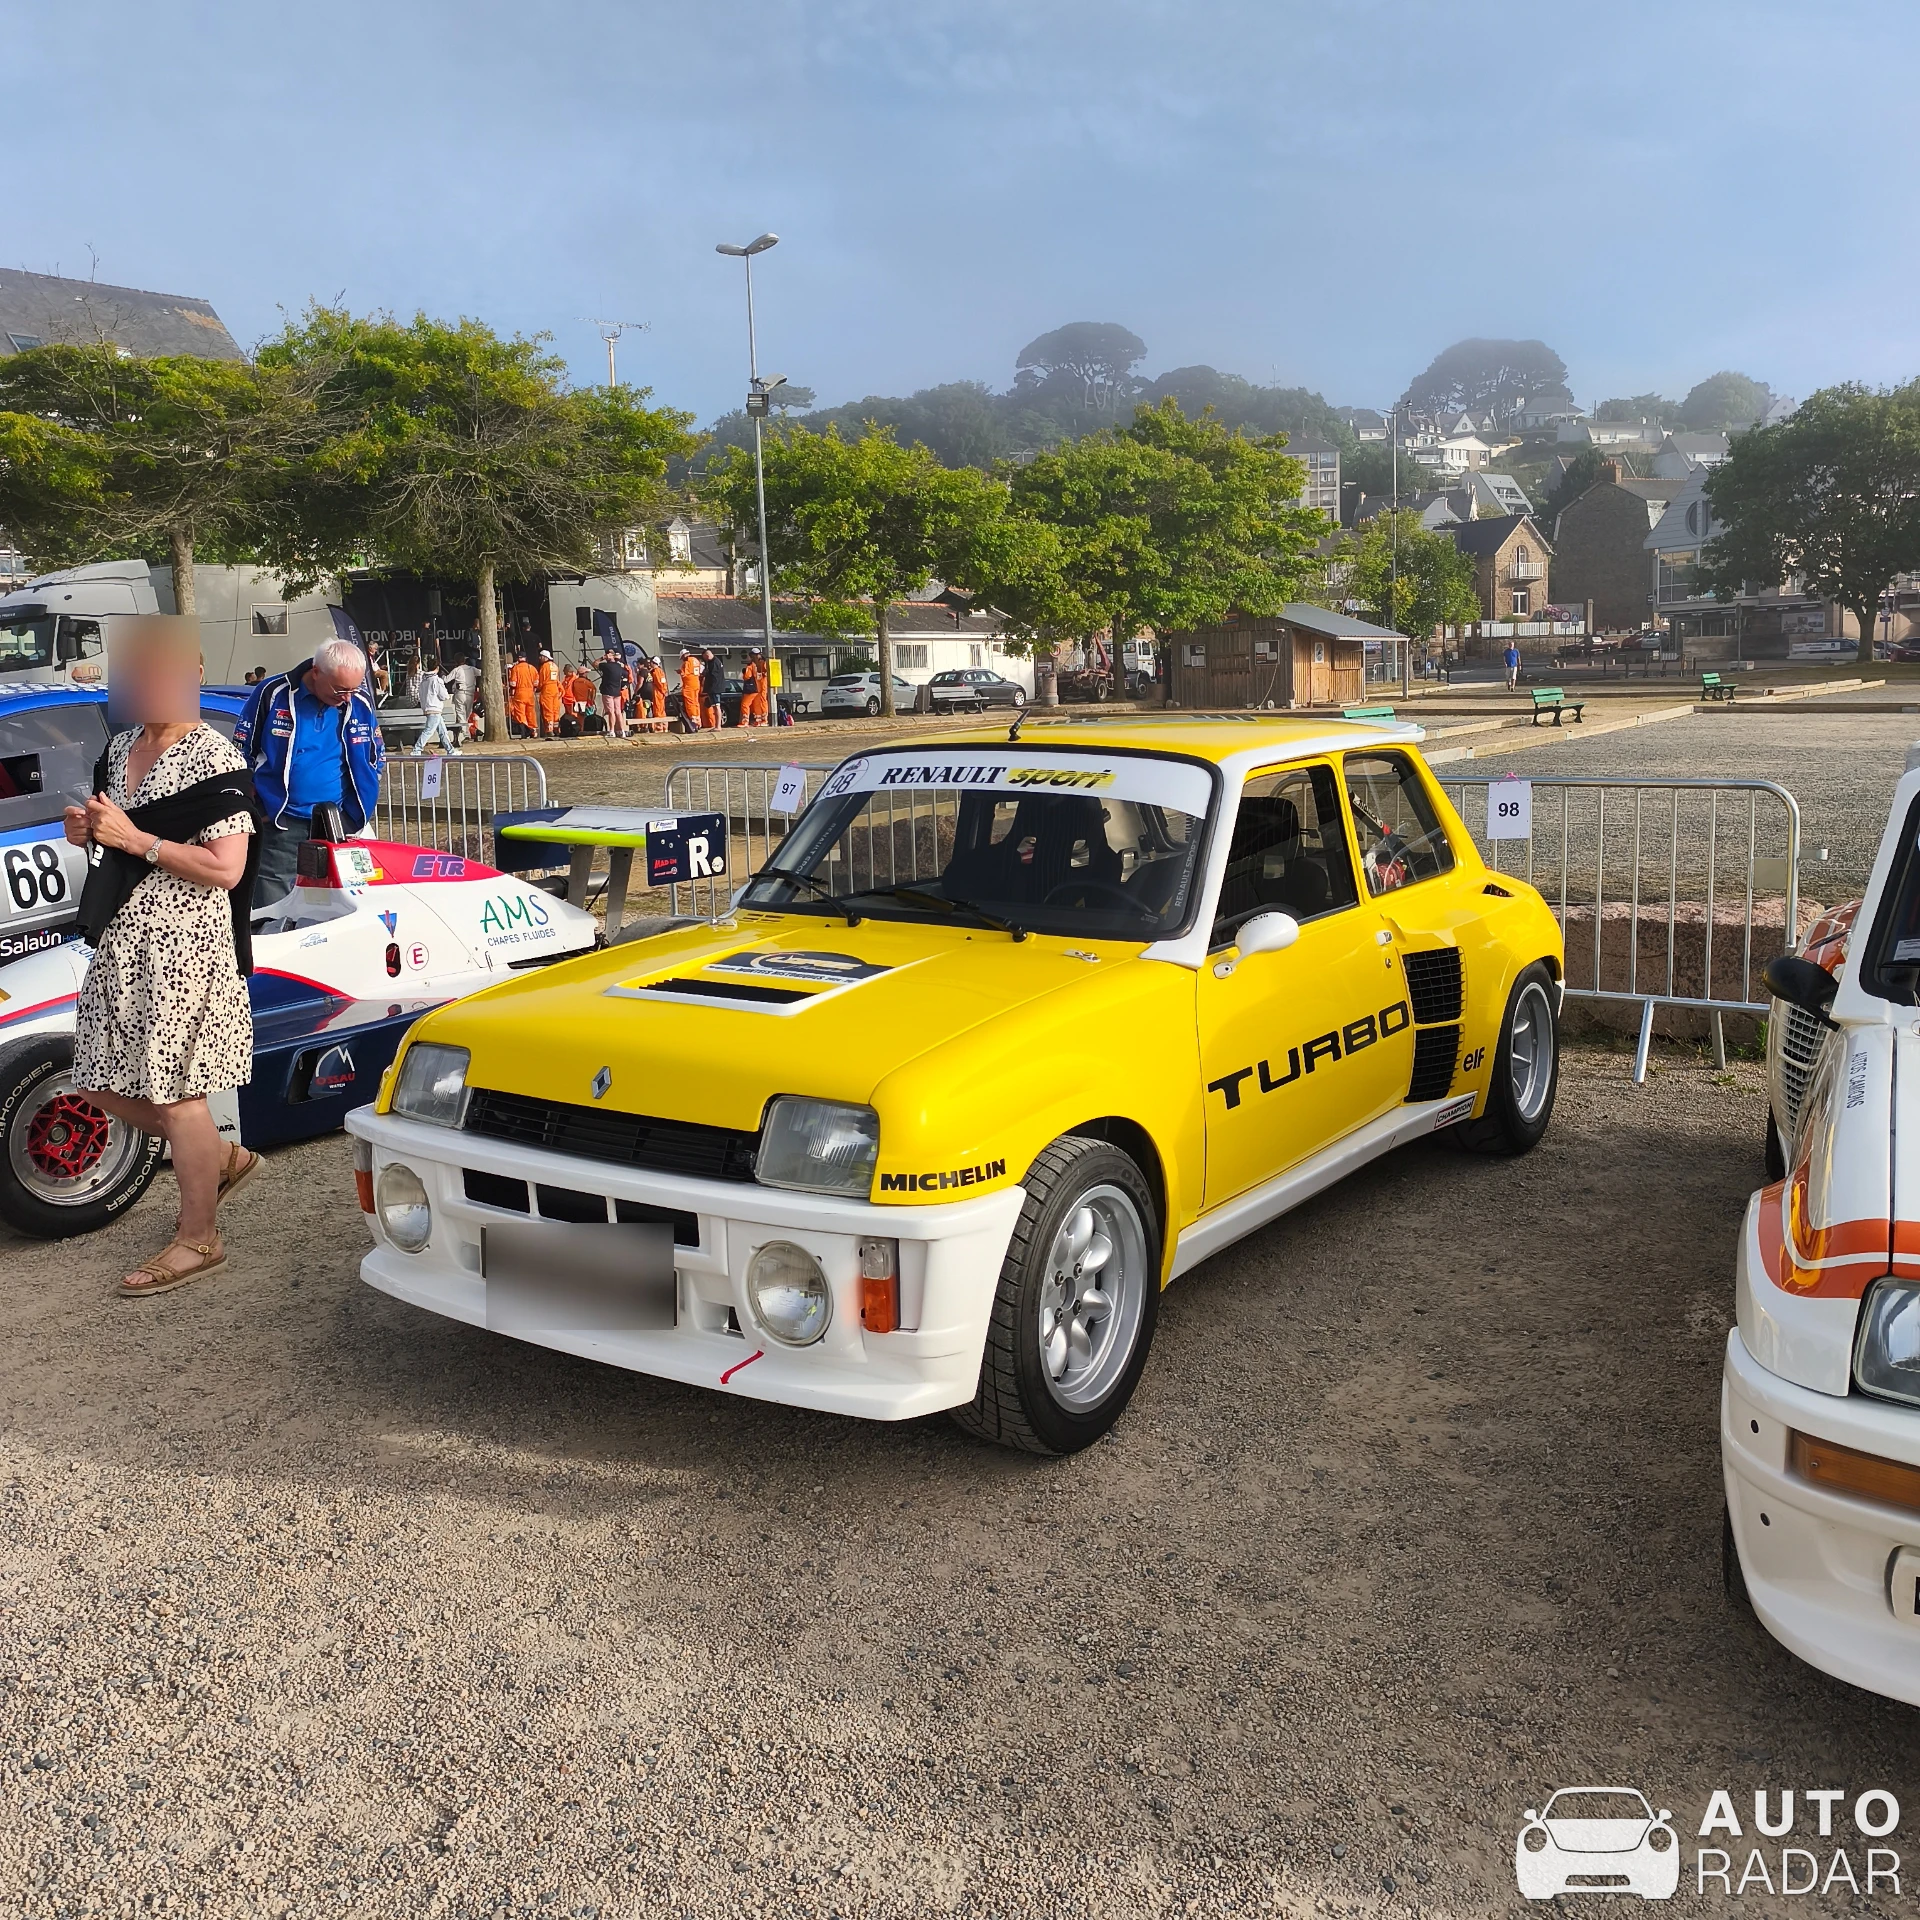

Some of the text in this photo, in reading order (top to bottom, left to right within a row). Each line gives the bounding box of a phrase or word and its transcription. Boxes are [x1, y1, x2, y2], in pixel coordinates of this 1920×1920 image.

[427, 773, 437, 785] 96
[825, 772, 857, 796] 98
[878, 766, 1007, 785] RENAULT
[1008, 768, 1113, 789] sport
[781, 783, 797, 796] 97
[1497, 801, 1520, 818] 98
[4, 844, 66, 909] 68
[1174, 840, 1197, 907] RENAULT SPORT
[480, 894, 549, 933] AMS
[487, 928, 556, 946] CHAPES FLUIDES
[413, 947, 424, 965] E
[1207, 1000, 1410, 1110] TURBO
[1463, 1046, 1486, 1072] elf
[315, 1072, 356, 1086] OSSAU
[1, 1061, 54, 1121] HOOSIER
[1437, 1101, 1473, 1124] CHAMPION
[216, 1123, 237, 1133] AFA
[105, 1152, 157, 1212] HOOSIER
[880, 1158, 1006, 1192] MICHELIN
